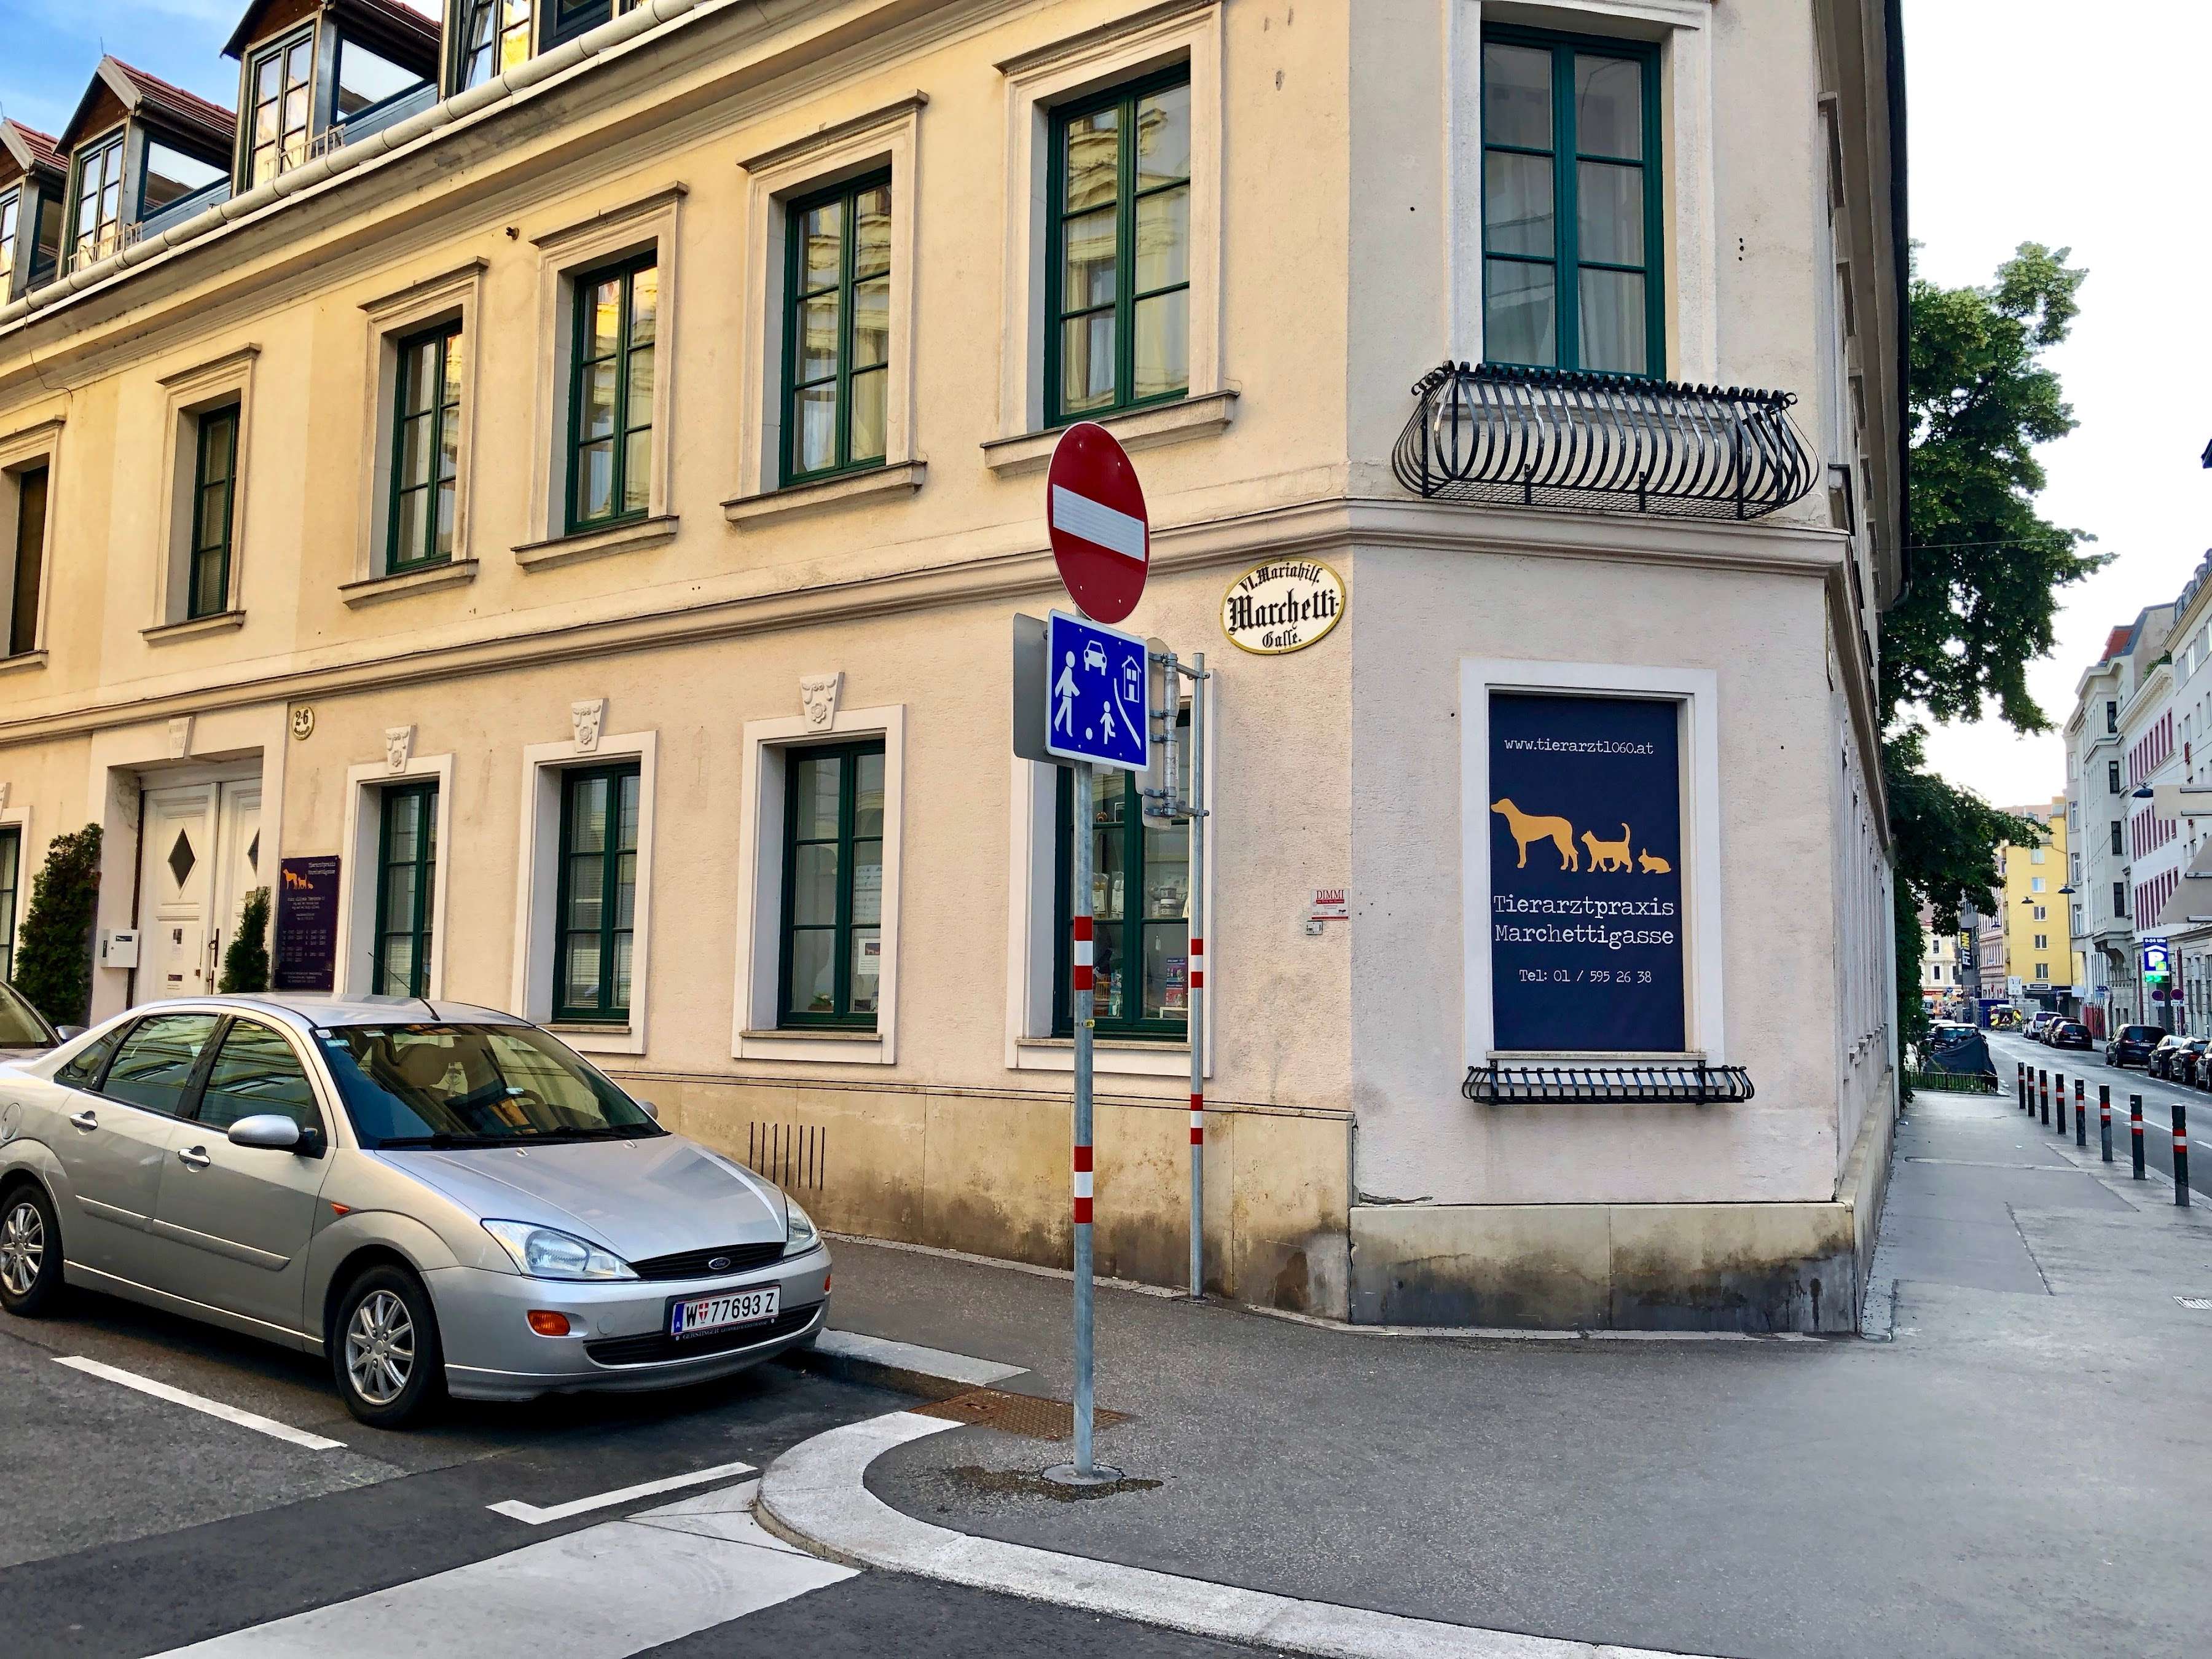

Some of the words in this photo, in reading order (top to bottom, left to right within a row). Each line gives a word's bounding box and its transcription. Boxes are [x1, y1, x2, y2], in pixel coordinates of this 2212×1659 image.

[1504, 738, 1654, 755] www.tierarzt1060.at
[1317, 890, 1344, 900] DIMMI
[1493, 894, 1674, 919] Tierarztpraxis
[1494, 924, 1674, 950] Marchettigasse
[1519, 970, 1547, 982] Tel:
[1553, 970, 1571, 982] 01
[1590, 970, 1610, 983] 595
[1616, 971, 1631, 983] 26
[1637, 971, 1652, 984] 38
[686, 1306, 697, 1327] W
[711, 1294, 761, 1323] 77693
[765, 1292, 774, 1313] Z
